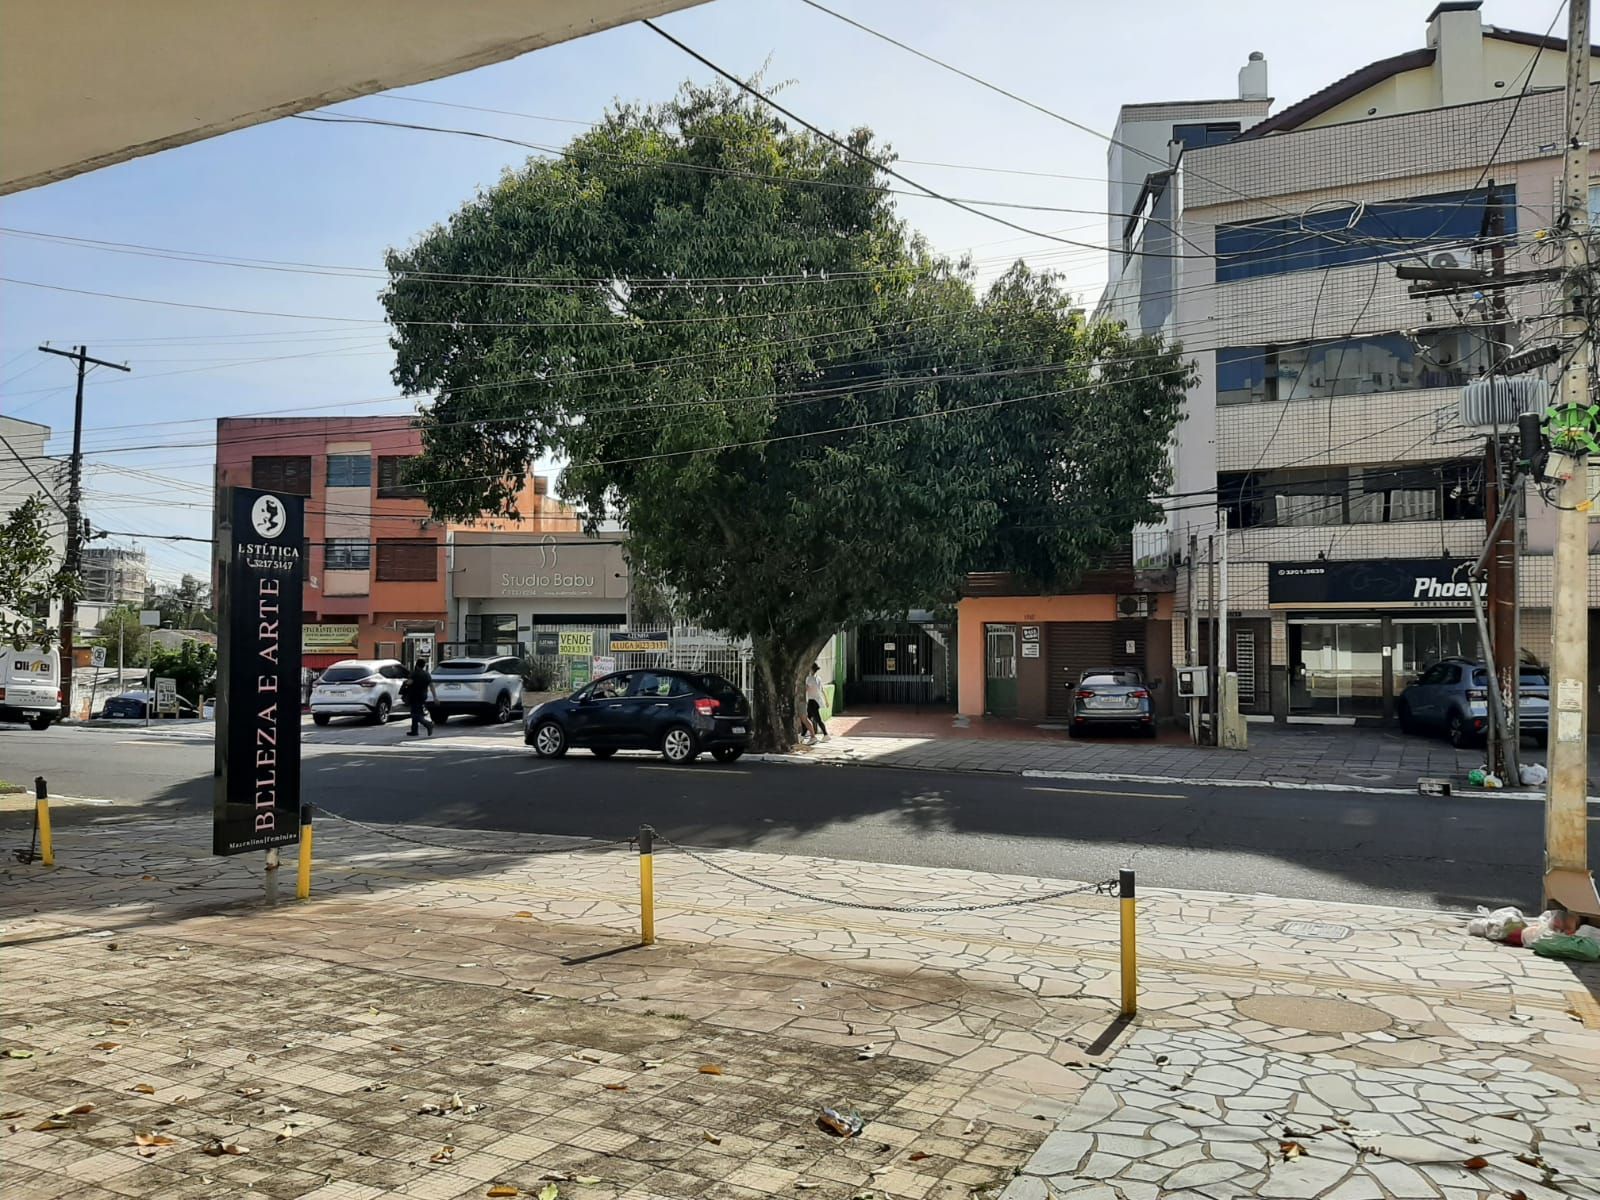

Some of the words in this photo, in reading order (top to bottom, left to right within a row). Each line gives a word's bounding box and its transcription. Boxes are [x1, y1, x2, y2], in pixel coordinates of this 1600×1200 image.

[238, 543, 299, 557] ESTÉTICA
[502, 573, 550, 587] Studio
[554, 573, 594, 587] Babu
[1413, 577, 1488, 598] Phoeni
[259, 577, 280, 665] ARTE
[560, 634, 592, 645] VENDE
[612, 642, 634, 650] ALUGA
[258, 675, 278, 693] E
[255, 703, 277, 833] BELEZA
